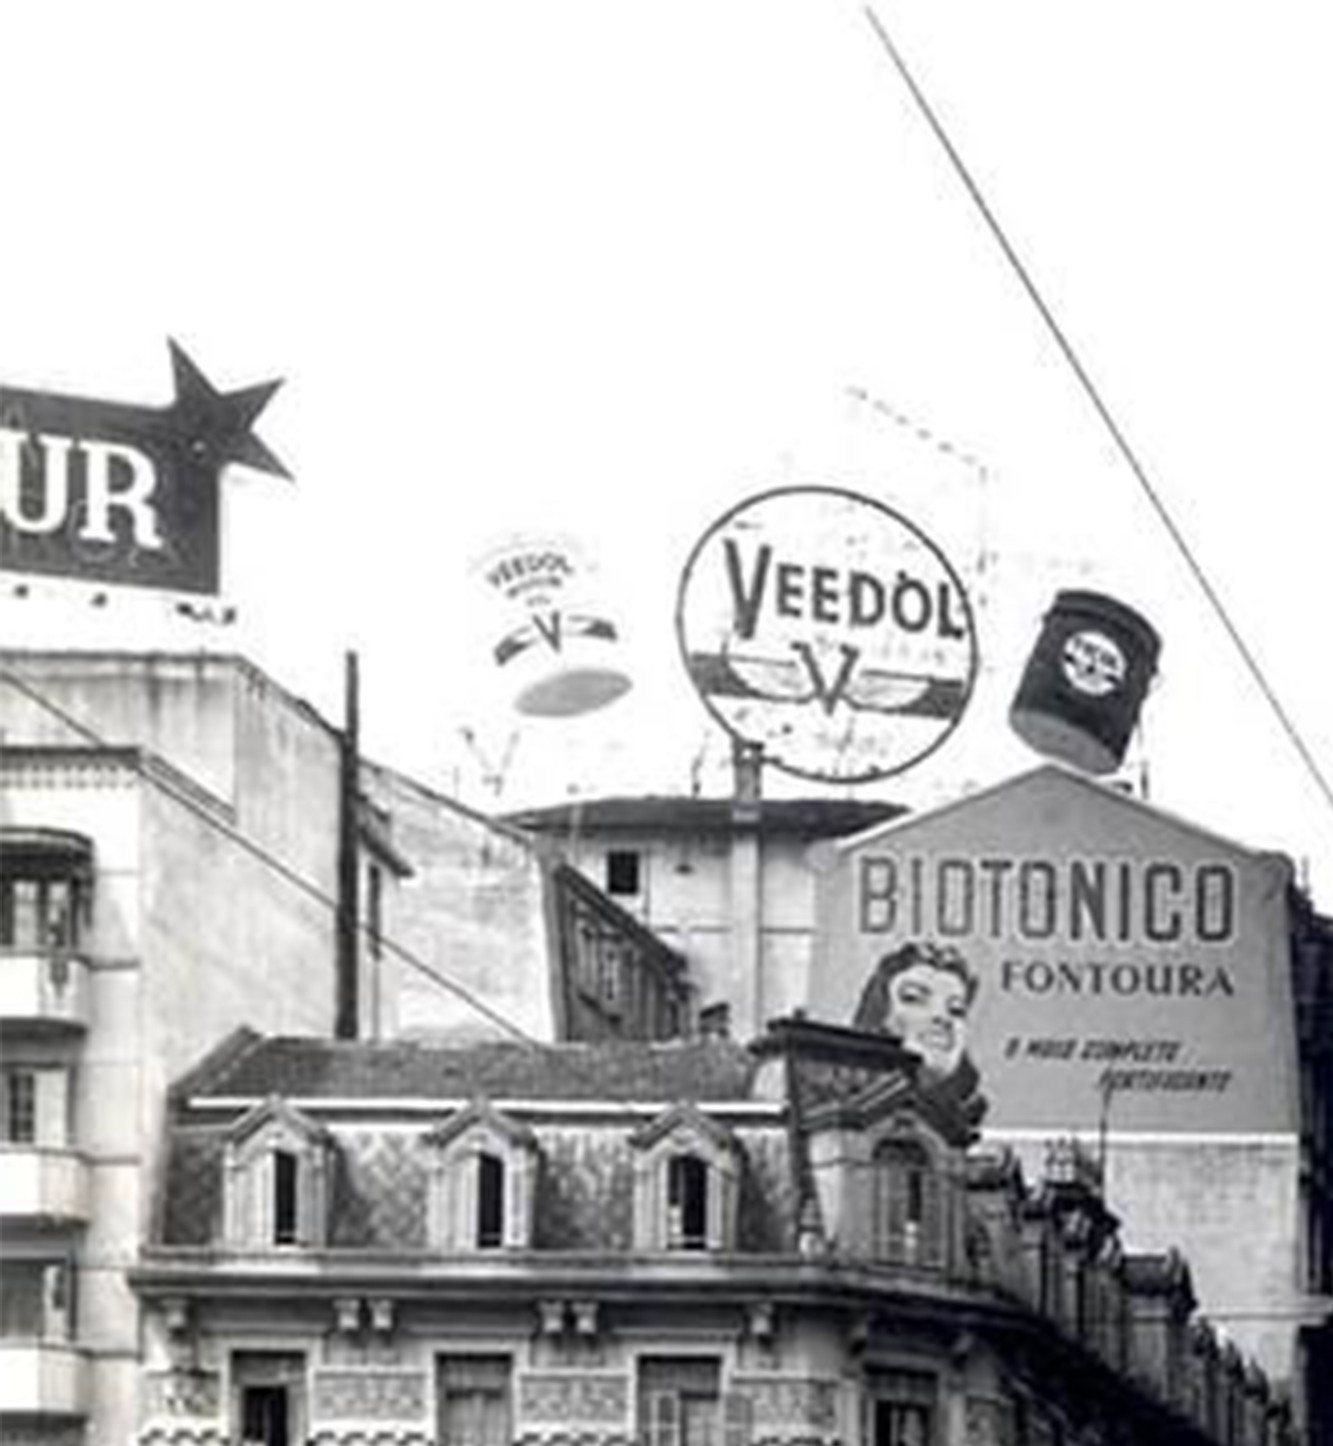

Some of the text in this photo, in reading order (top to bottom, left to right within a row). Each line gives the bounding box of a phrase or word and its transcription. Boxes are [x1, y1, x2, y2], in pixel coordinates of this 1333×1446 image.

[722, 537, 964, 641] VEEDOL
[859, 856, 1234, 942] BIOTONICO
[1001, 960, 1236, 997] FONTOURA
